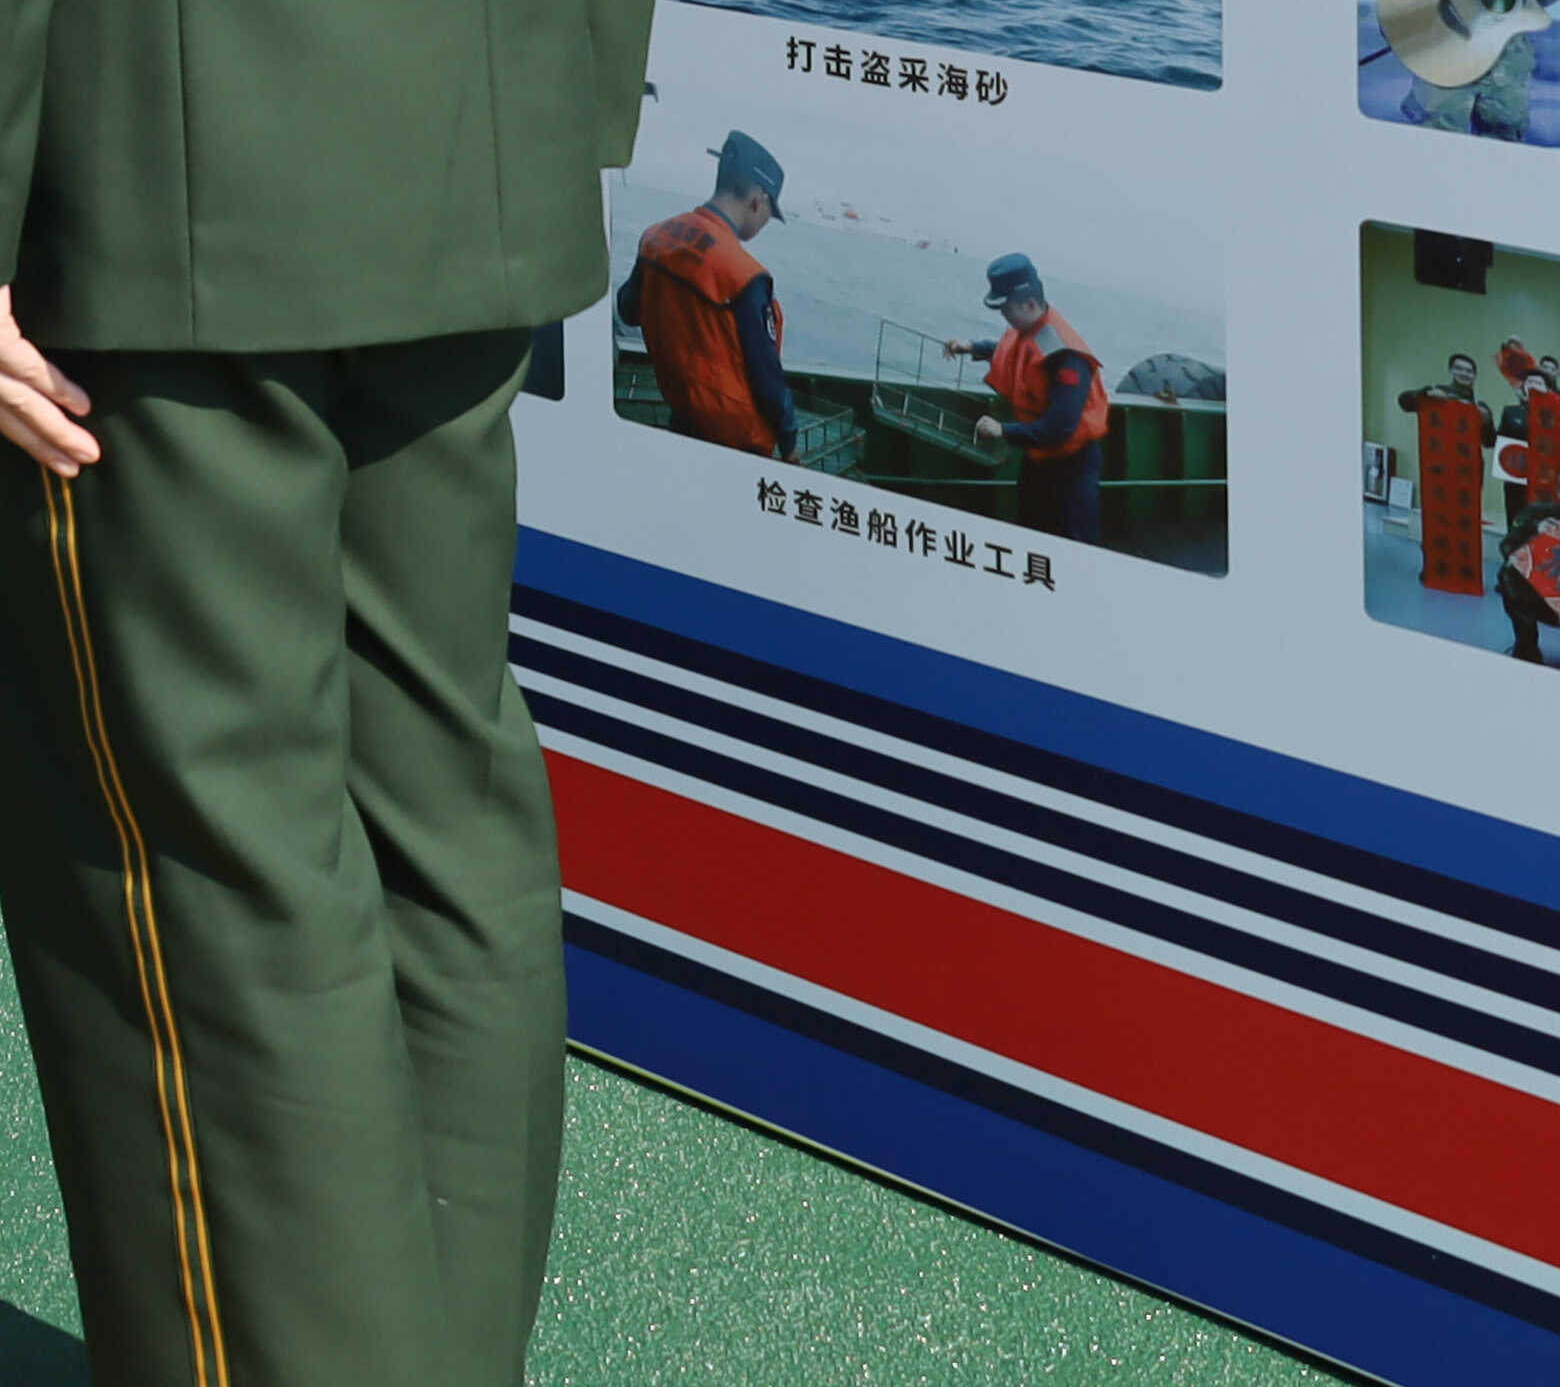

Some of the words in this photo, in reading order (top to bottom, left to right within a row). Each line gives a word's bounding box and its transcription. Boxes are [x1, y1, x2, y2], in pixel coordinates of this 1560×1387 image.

[785, 35, 1009, 106] 打击盗采海砂
[755, 477, 1058, 591] 检查渔船作业工具
